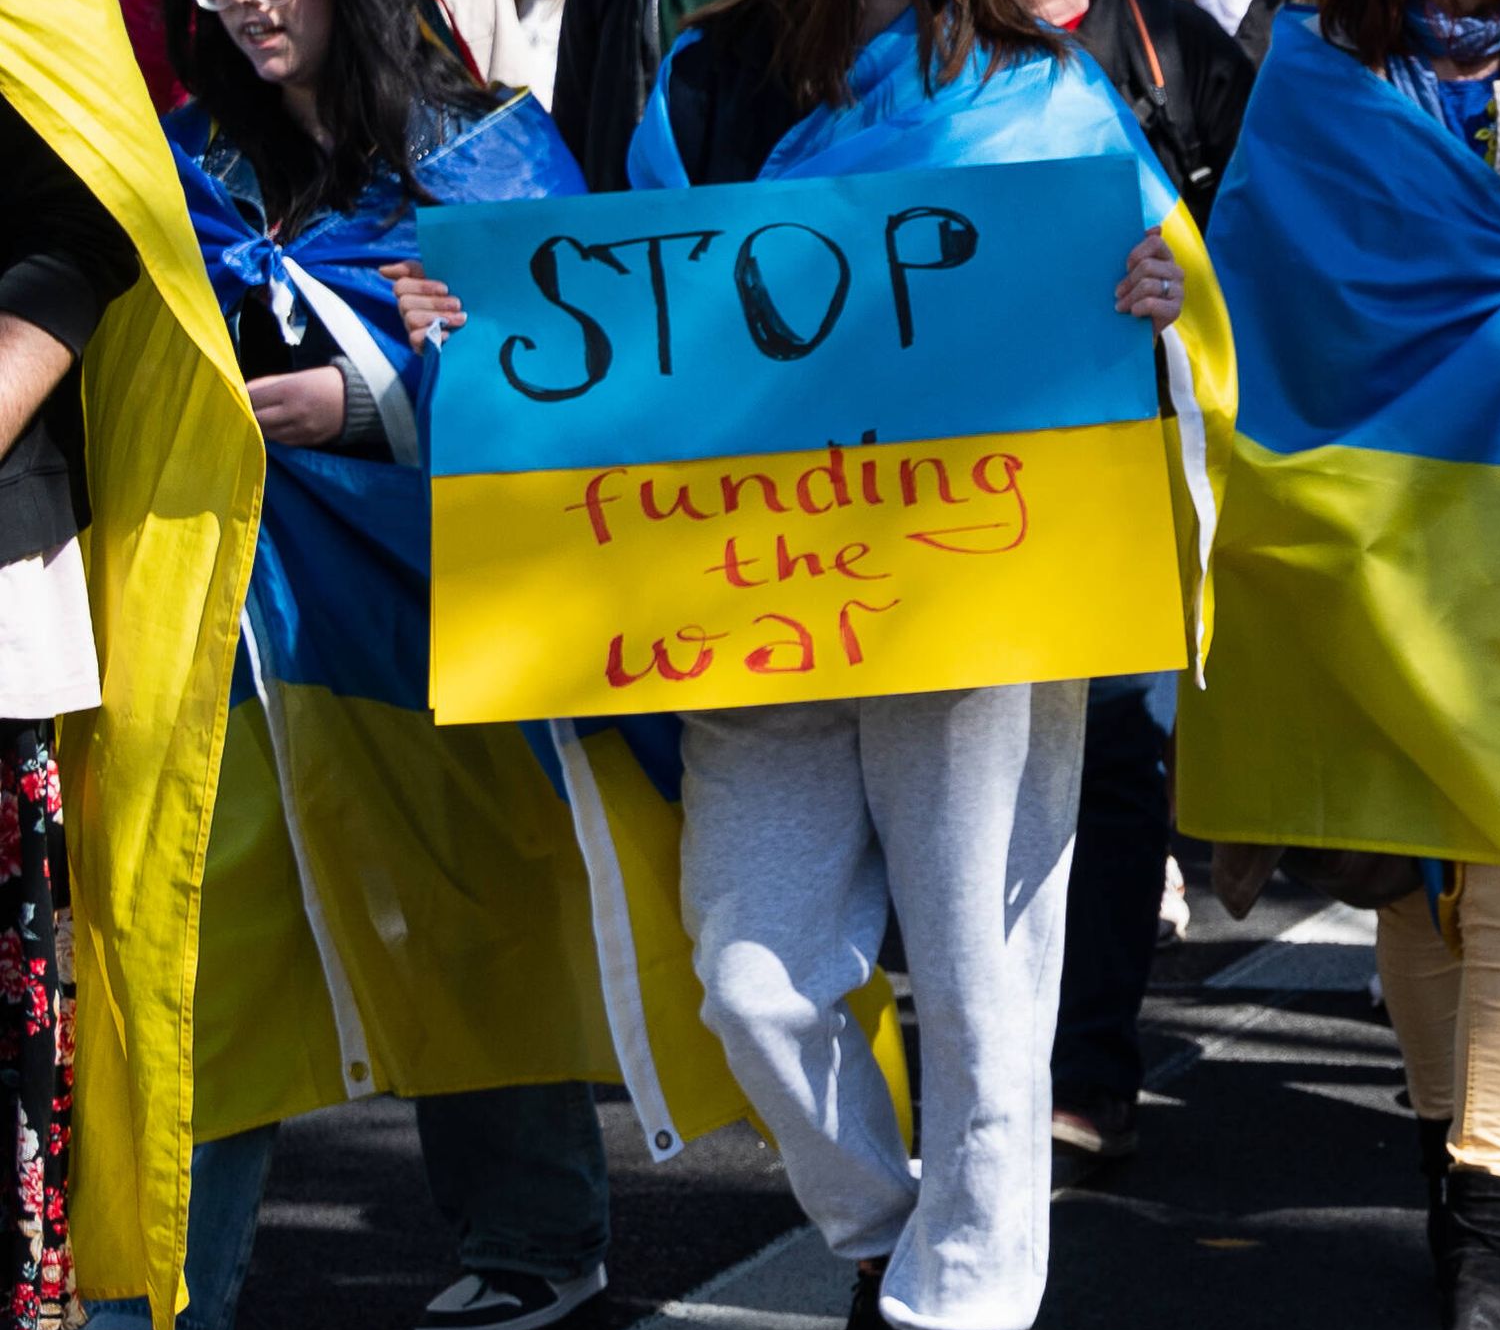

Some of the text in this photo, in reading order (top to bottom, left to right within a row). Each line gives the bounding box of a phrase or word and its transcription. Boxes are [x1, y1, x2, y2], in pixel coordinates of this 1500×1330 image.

[497, 204, 980, 402] STOP
[564, 429, 1028, 555] funding
[703, 533, 894, 589] the
[603, 597, 902, 690] war
